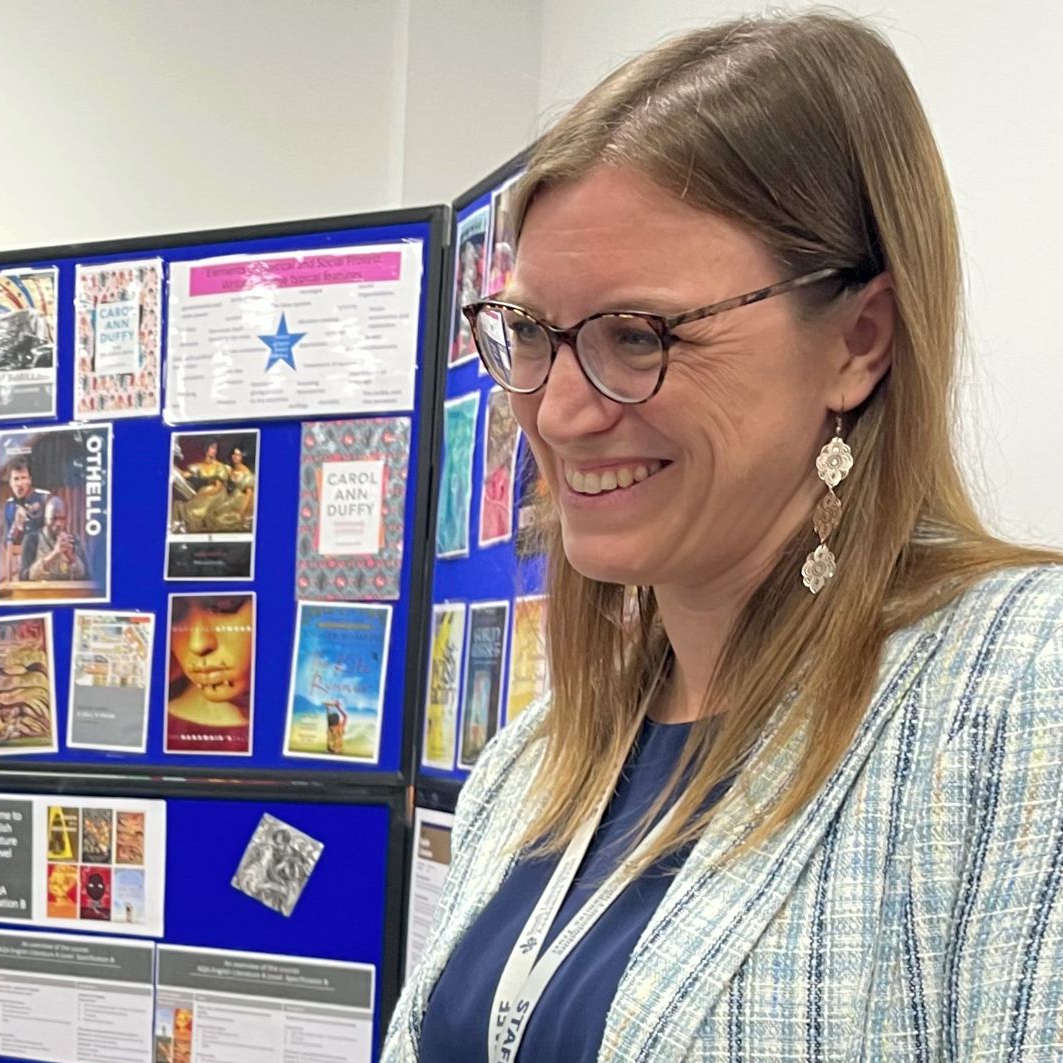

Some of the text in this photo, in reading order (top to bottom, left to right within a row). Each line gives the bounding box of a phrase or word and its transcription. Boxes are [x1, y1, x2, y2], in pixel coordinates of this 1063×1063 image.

[99, 305, 138, 319] CARO
[105, 319, 130, 330] ANN
[99, 330, 134, 344] DUFFY
[85, 434, 102, 536] OTHELLO
[327, 472, 377, 486] CAROL
[334, 487, 368, 501] ANN
[326, 503, 375, 517] DUFFY
[11, 810, 23, 821] to
[19, 898, 27, 910] B
